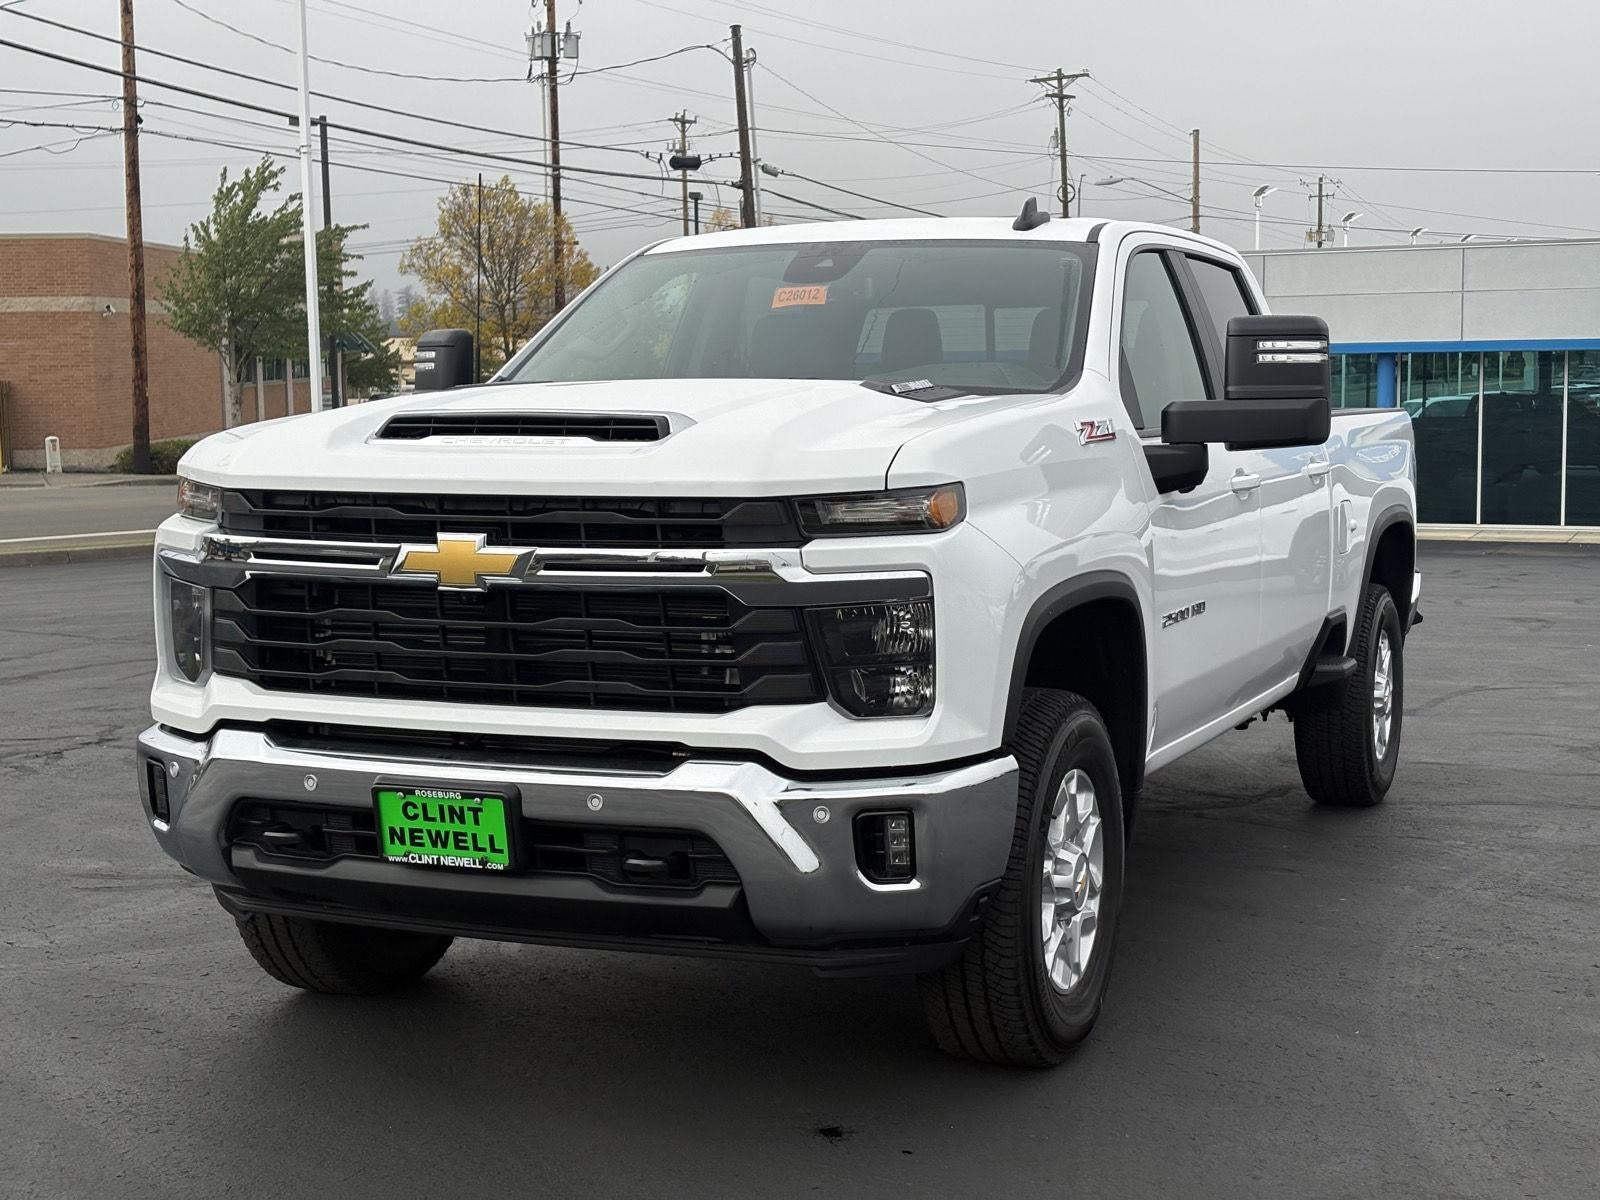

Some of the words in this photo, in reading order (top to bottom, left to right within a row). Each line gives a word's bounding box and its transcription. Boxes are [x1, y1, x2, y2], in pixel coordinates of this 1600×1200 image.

[778, 288, 820, 302] C26012
[441, 436, 571, 445] CHEVROLET
[415, 789, 462, 800] ROSEBURG
[401, 800, 483, 826] CLINT
[388, 826, 504, 854] NEWELL
